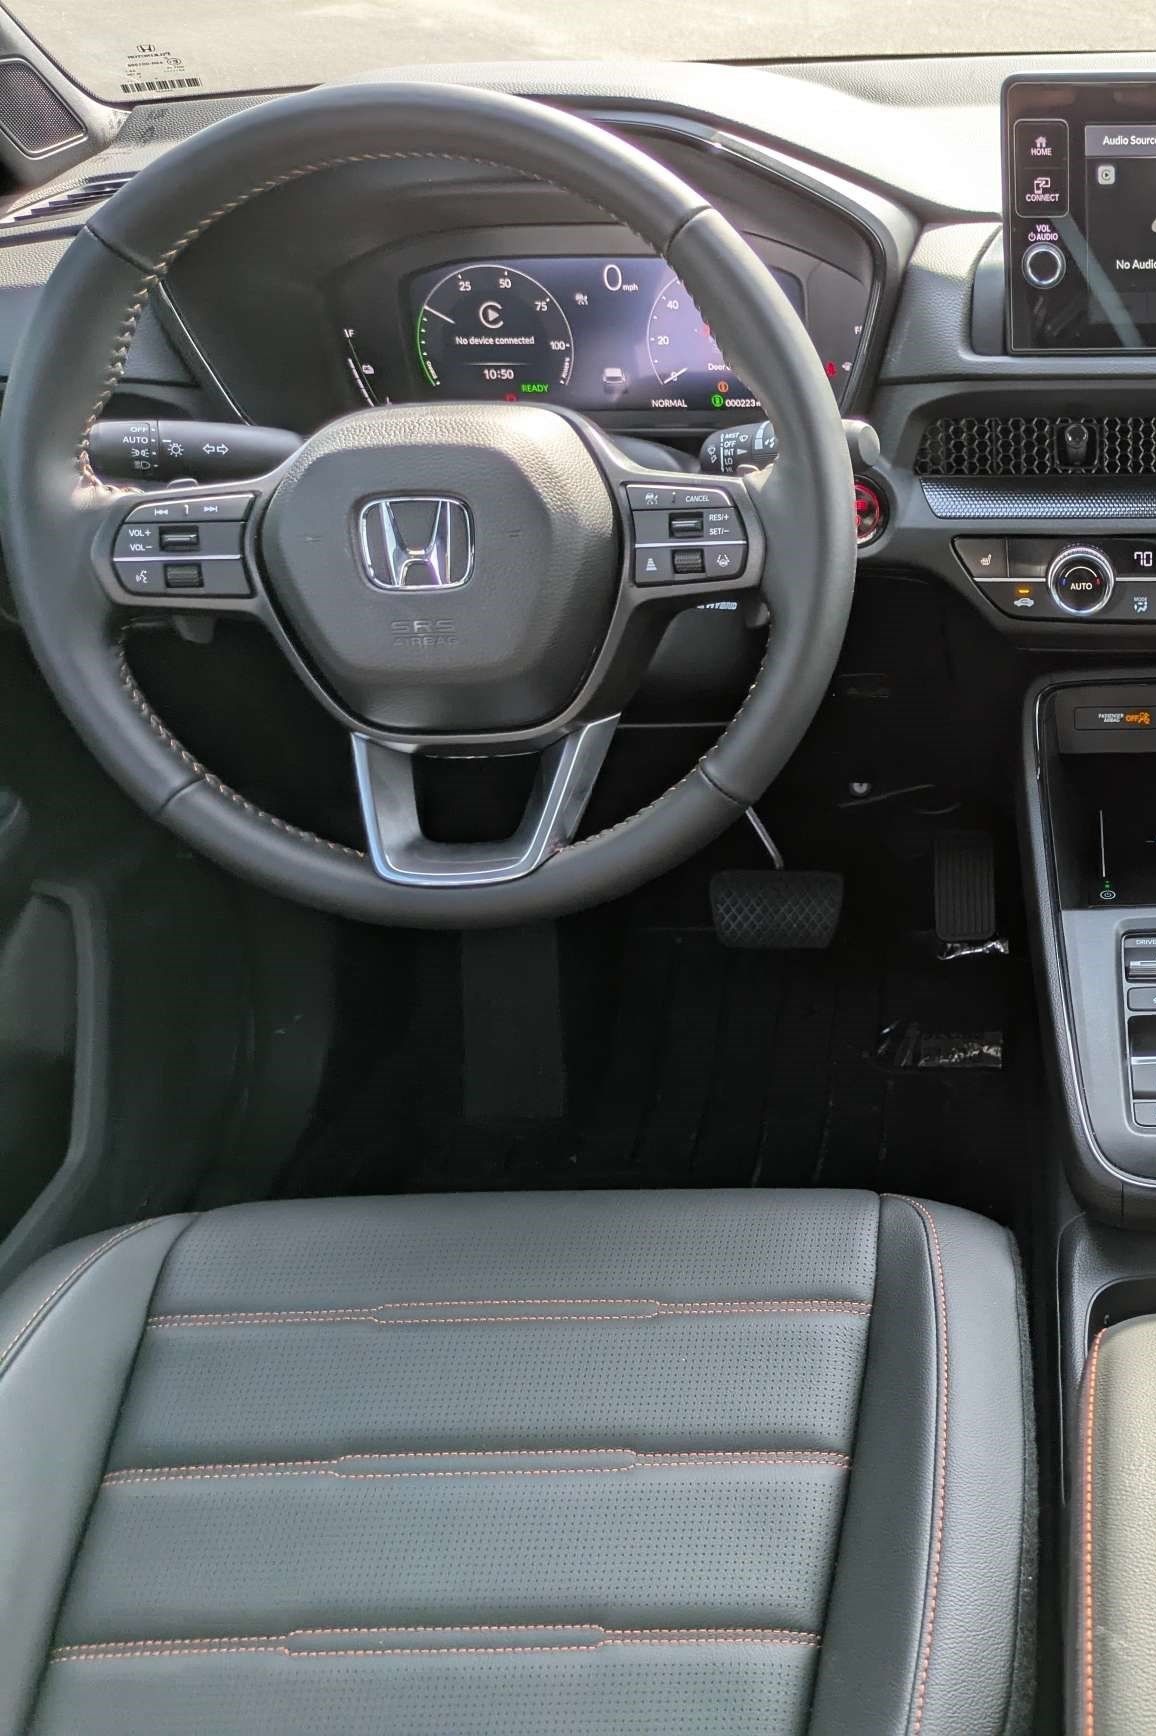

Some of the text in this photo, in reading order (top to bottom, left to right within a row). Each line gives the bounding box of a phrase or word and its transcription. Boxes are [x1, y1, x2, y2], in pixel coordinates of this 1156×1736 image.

[1102, 135, 1129, 146] Audio
[1031, 148, 1052, 156] HOME
[1025, 194, 1059, 202] CONNECT
[1036, 224, 1051, 233] VOL
[1036, 232, 1058, 241] AUDIO
[1116, 259, 1130, 269] No
[499, 278, 511, 288] 50
[603, 264, 638, 293] 0 mph
[459, 281, 471, 291] 25
[534, 301, 547, 311] 75
[667, 301, 679, 310] 40
[456, 336, 535, 345] No device connected
[657, 336, 669, 345] 20
[550, 341, 565, 350] 100
[483, 369, 514, 380] 10:50
[521, 384, 549, 392] READY
[652, 400, 688, 408] NORMAL
[725, 399, 756, 408] 000223
[724, 440, 736, 448] OFF
[1134, 551, 1153, 567] 70
[1070, 582, 1092, 590] AUTO
[391, 619, 455, 633] SRS
